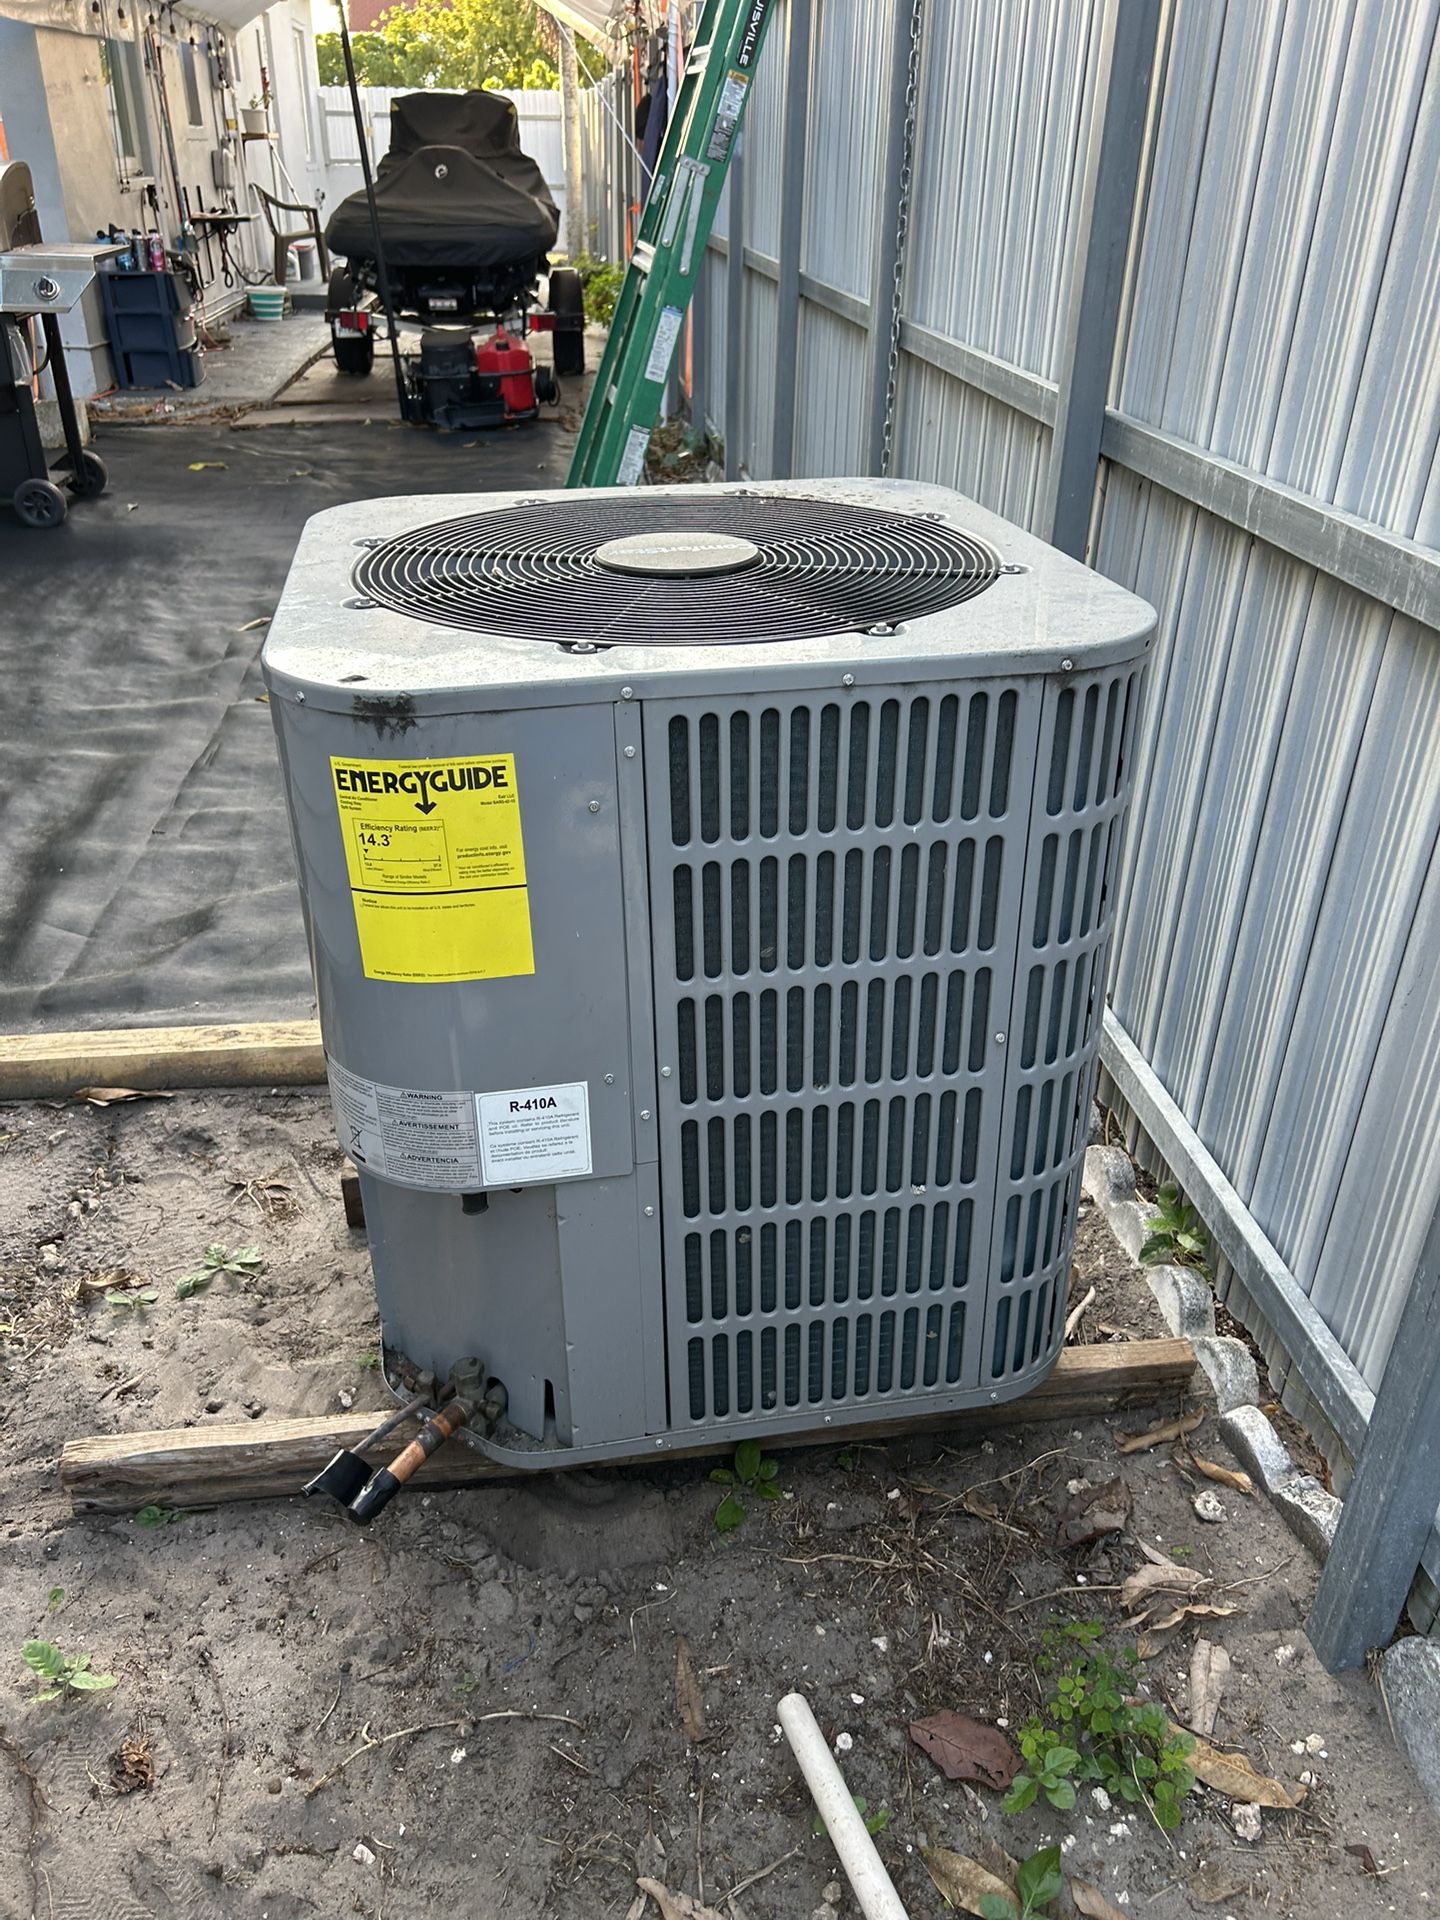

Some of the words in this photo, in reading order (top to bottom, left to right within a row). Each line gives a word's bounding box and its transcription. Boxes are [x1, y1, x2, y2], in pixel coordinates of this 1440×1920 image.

[335, 765, 508, 793] ENERGYGUIDE
[360, 823, 393, 832] Efficiency
[395, 825, 418, 833] Rating
[407, 1092, 443, 1100] WARNING
[510, 1097, 557, 1112] R-410A
[399, 1120, 459, 1130] AVERTISSEMENT
[407, 1154, 459, 1163] ADVERTENCIA
